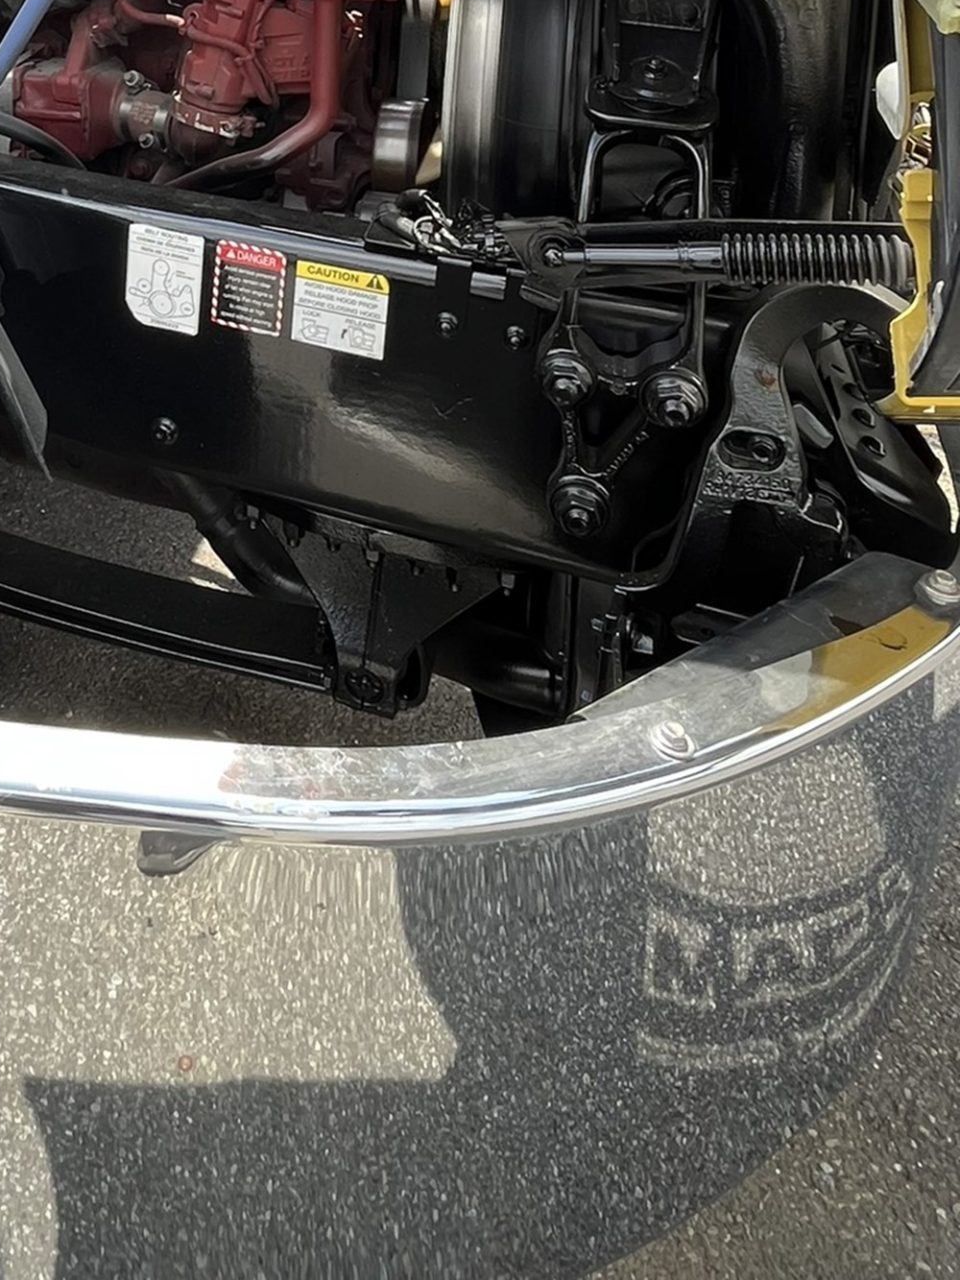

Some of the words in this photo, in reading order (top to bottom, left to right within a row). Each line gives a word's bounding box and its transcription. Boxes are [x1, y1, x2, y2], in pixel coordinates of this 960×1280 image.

[236, 250, 277, 267] DANGER
[307, 265, 360, 283] CAUTION
[304, 281, 324, 290] AVOID
[326, 285, 347, 294] HOOD
[299, 297, 326, 308] BEFORE
[326, 303, 358, 315] CLOSING
[359, 311, 381, 320] HOOD
[304, 290, 334, 300] RELEASE
[335, 296, 357, 306] HOOD
[358, 301, 379, 310] PROP
[302, 309, 321, 317] LOCK
[344, 318, 376, 329] RELEASE
